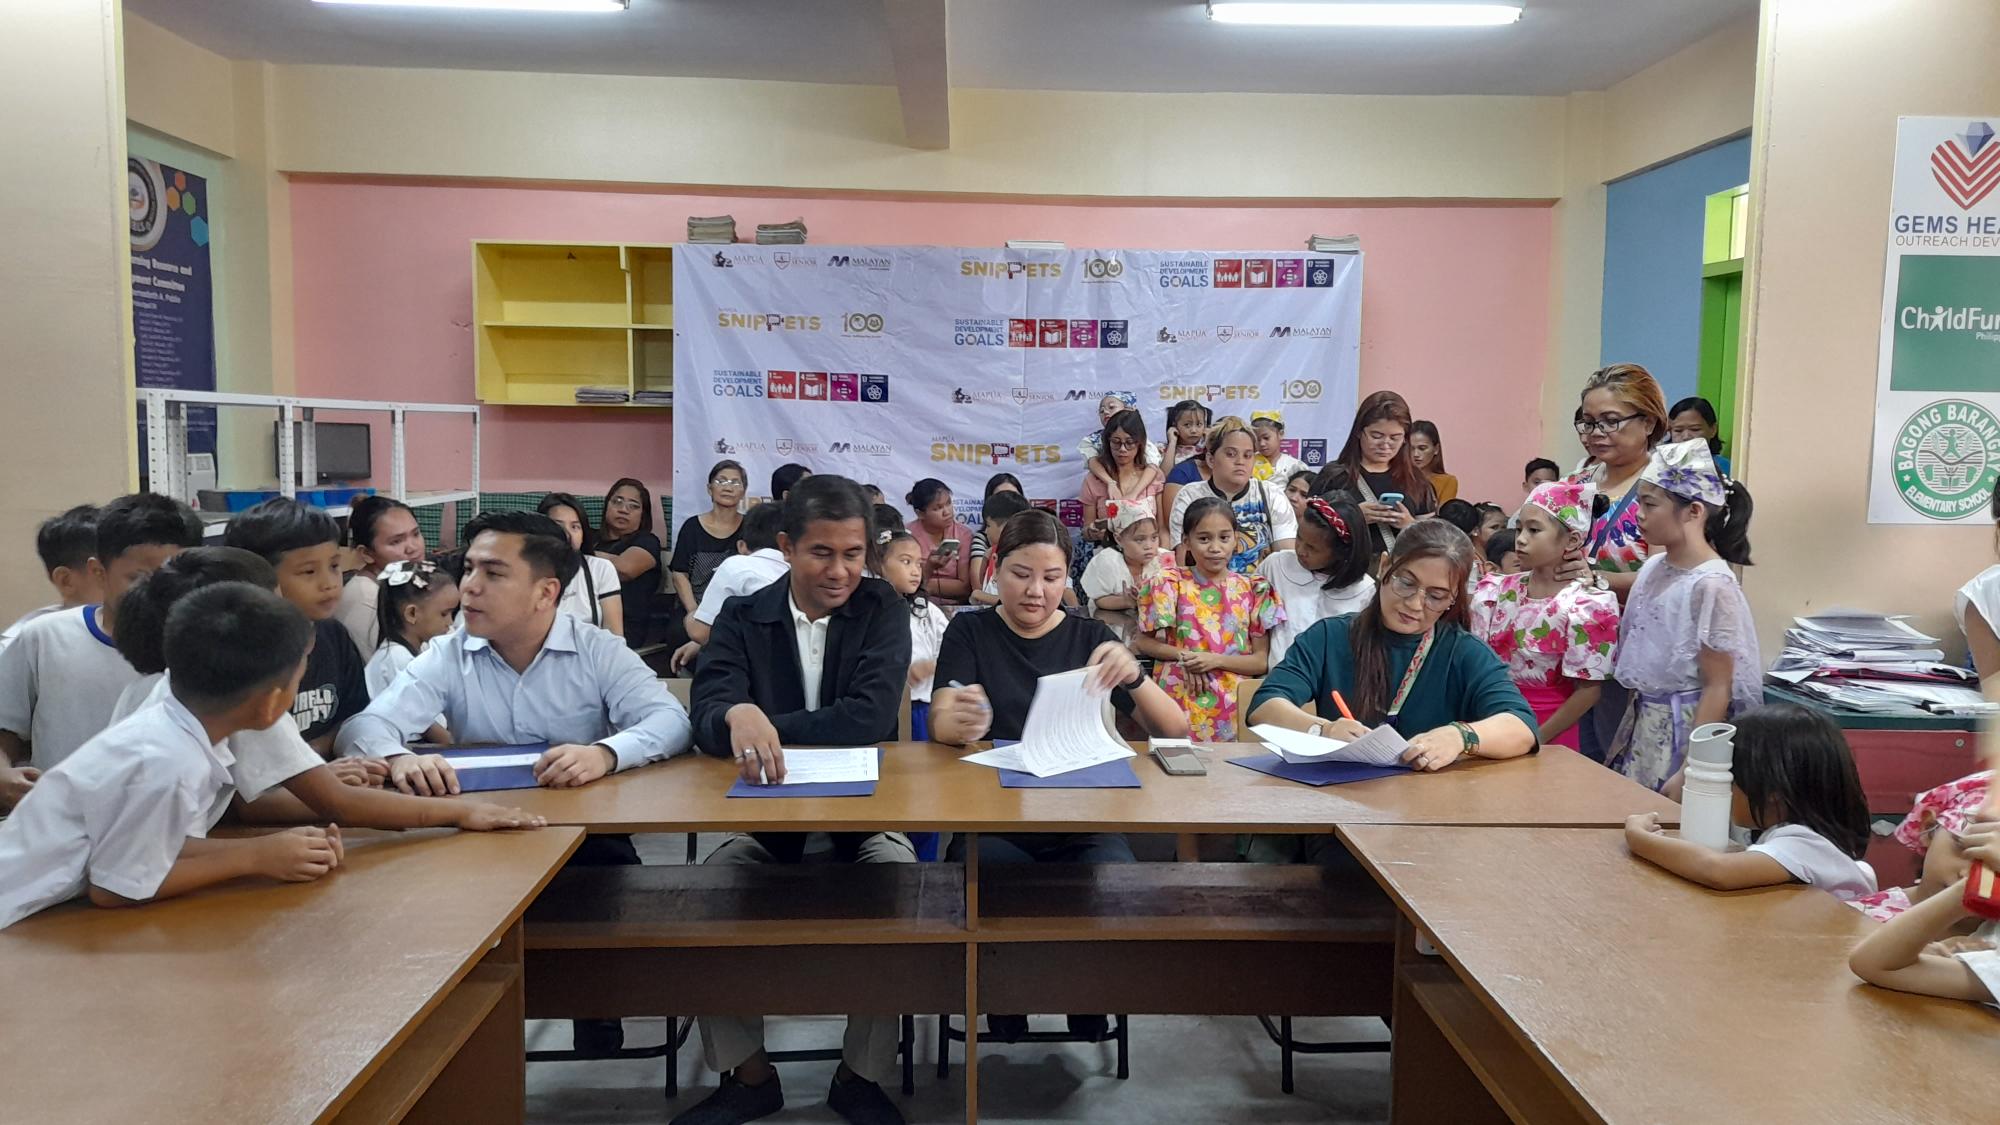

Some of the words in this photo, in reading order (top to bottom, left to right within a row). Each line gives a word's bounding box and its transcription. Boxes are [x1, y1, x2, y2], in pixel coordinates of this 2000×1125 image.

[1894, 215, 1958, 234] GEMS
[1966, 216, 2000, 234] HE
[1896, 235, 1968, 247] OUTREACH
[852, 257, 891, 266] MALAYAN
[961, 260, 1062, 279] SNIPPETS
[1160, 275, 1209, 288] GOALS
[718, 312, 821, 331] SNIPPETS
[955, 318, 1004, 326] SUSTAINABLE
[954, 333, 1004, 346] GOALS
[713, 377, 762, 385] DEVELOPMENT
[714, 370, 761, 378] SUSTAINABLE
[713, 384, 763, 398] GOALS
[1159, 384, 1260, 401] SNIPPETS
[1280, 379, 1322, 399] 100
[1898, 407, 1941, 471] BAGONG
[853, 443, 892, 452] MALAYAN
[930, 443, 1061, 465] SNIPPETS
[1905, 485, 1957, 513] ELEMENTARY
[1958, 487, 1992, 512] SCHOOL
